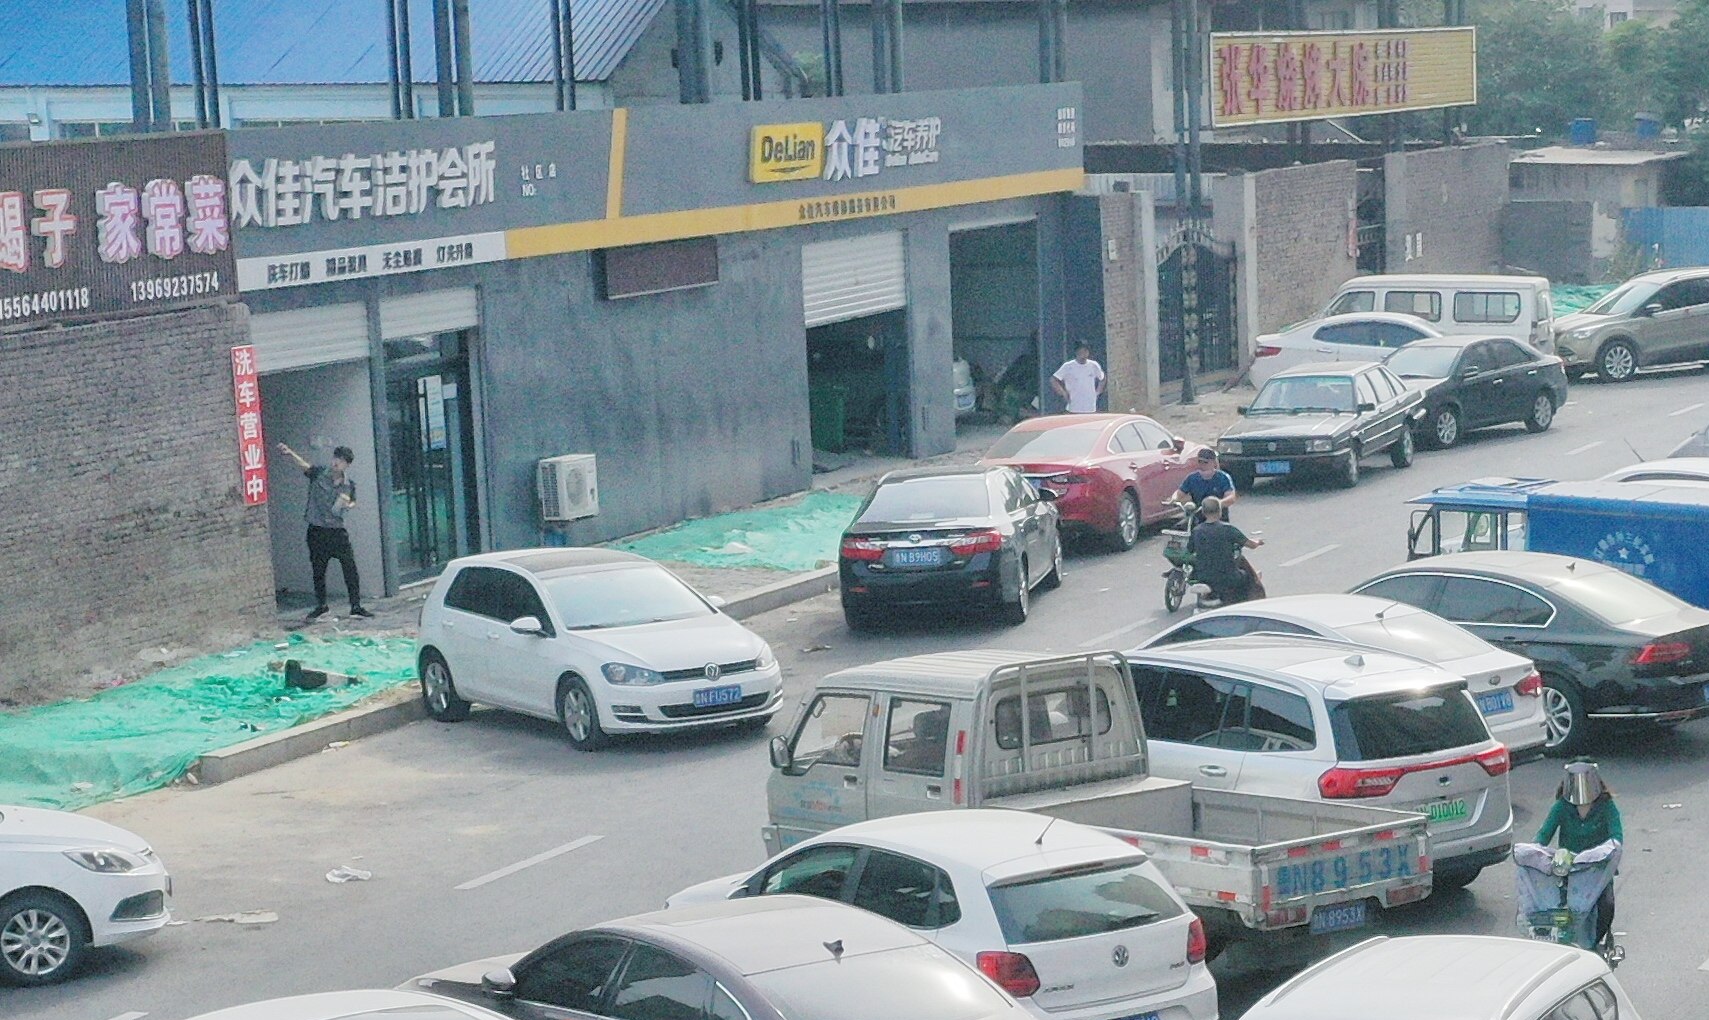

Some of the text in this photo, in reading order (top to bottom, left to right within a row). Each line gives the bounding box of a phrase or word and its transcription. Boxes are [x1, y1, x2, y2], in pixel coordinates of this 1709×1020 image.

[229, 140, 496, 228] 众佳汽车洁护会所
[761, 134, 816, 164] DeLian
[823, 117, 881, 181] 众佳
[96, 174, 229, 264] 家常菜
[130, 271, 219, 302] 13969237574
[235, 348, 264, 502] 洗车营业中
